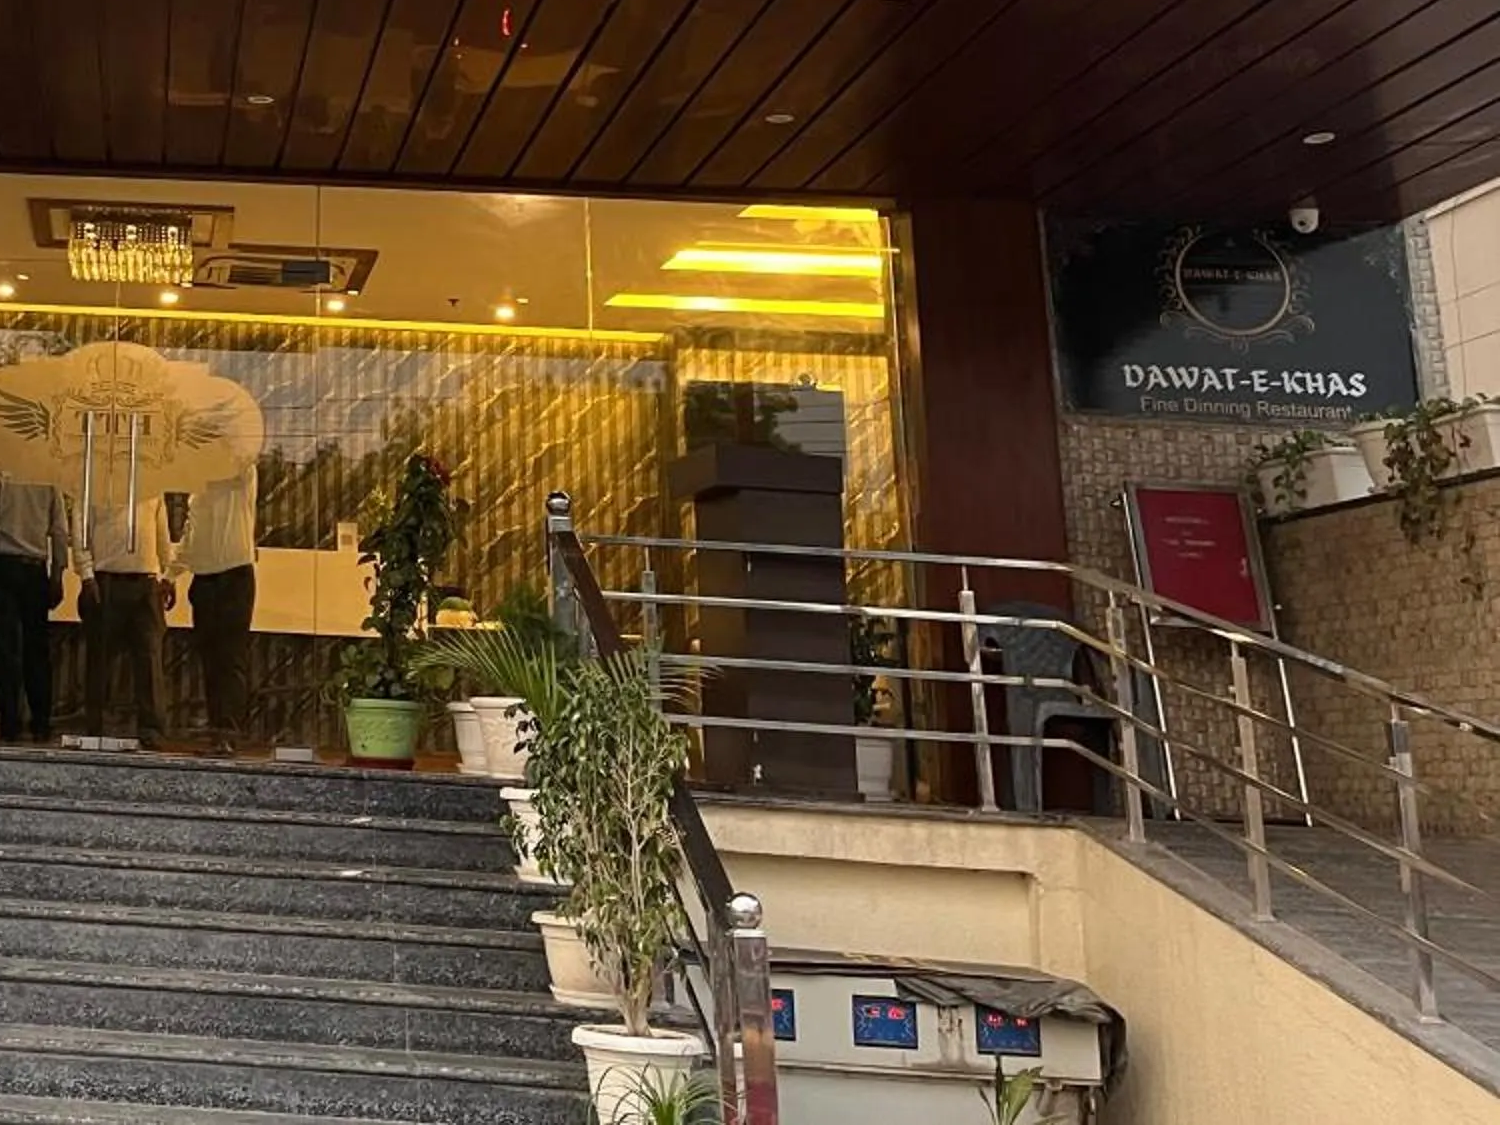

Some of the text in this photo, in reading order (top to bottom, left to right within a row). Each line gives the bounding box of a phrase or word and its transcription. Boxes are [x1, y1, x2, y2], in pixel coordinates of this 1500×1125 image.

[1123, 365, 1367, 398] DAWAT-E-KHAS
[1140, 397, 1179, 412] Fine
[1256, 400, 1352, 420] Restaurant
